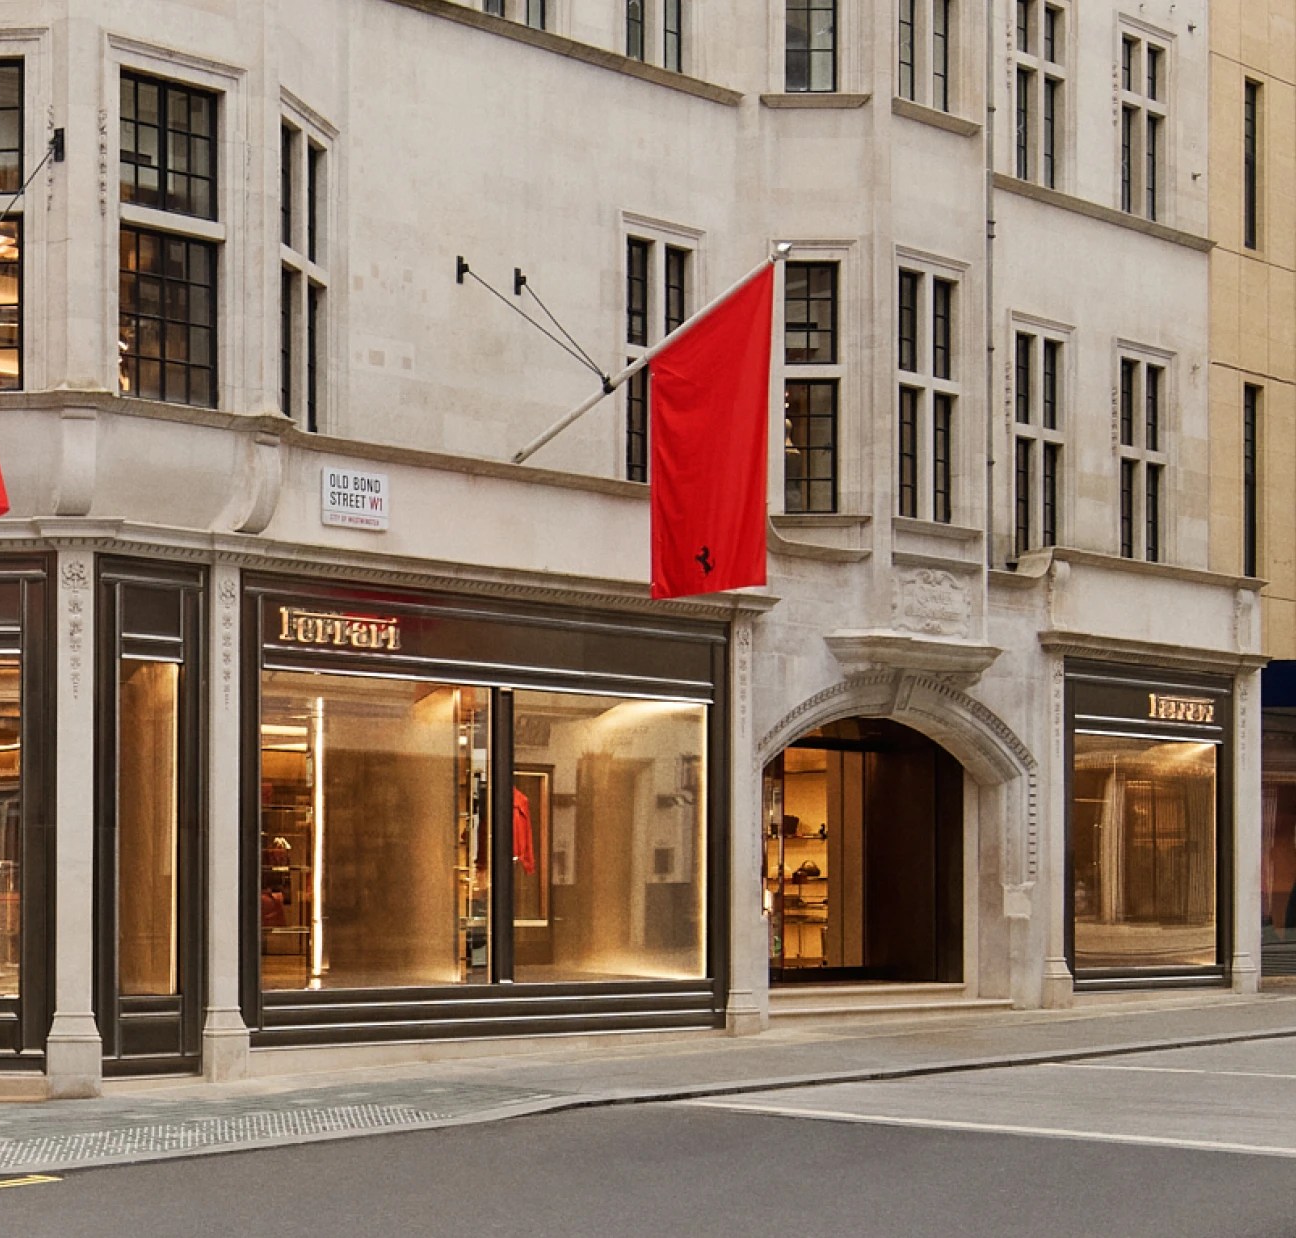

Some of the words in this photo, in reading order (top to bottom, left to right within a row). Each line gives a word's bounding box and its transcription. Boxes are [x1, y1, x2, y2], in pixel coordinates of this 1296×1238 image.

[329, 473, 349, 489] OLD
[353, 476, 381, 494] BOND
[329, 491, 366, 509] STREET
[369, 496, 383, 512] W1
[279, 606, 402, 650] Ferrari
[1149, 693, 1215, 723] Ferrari
